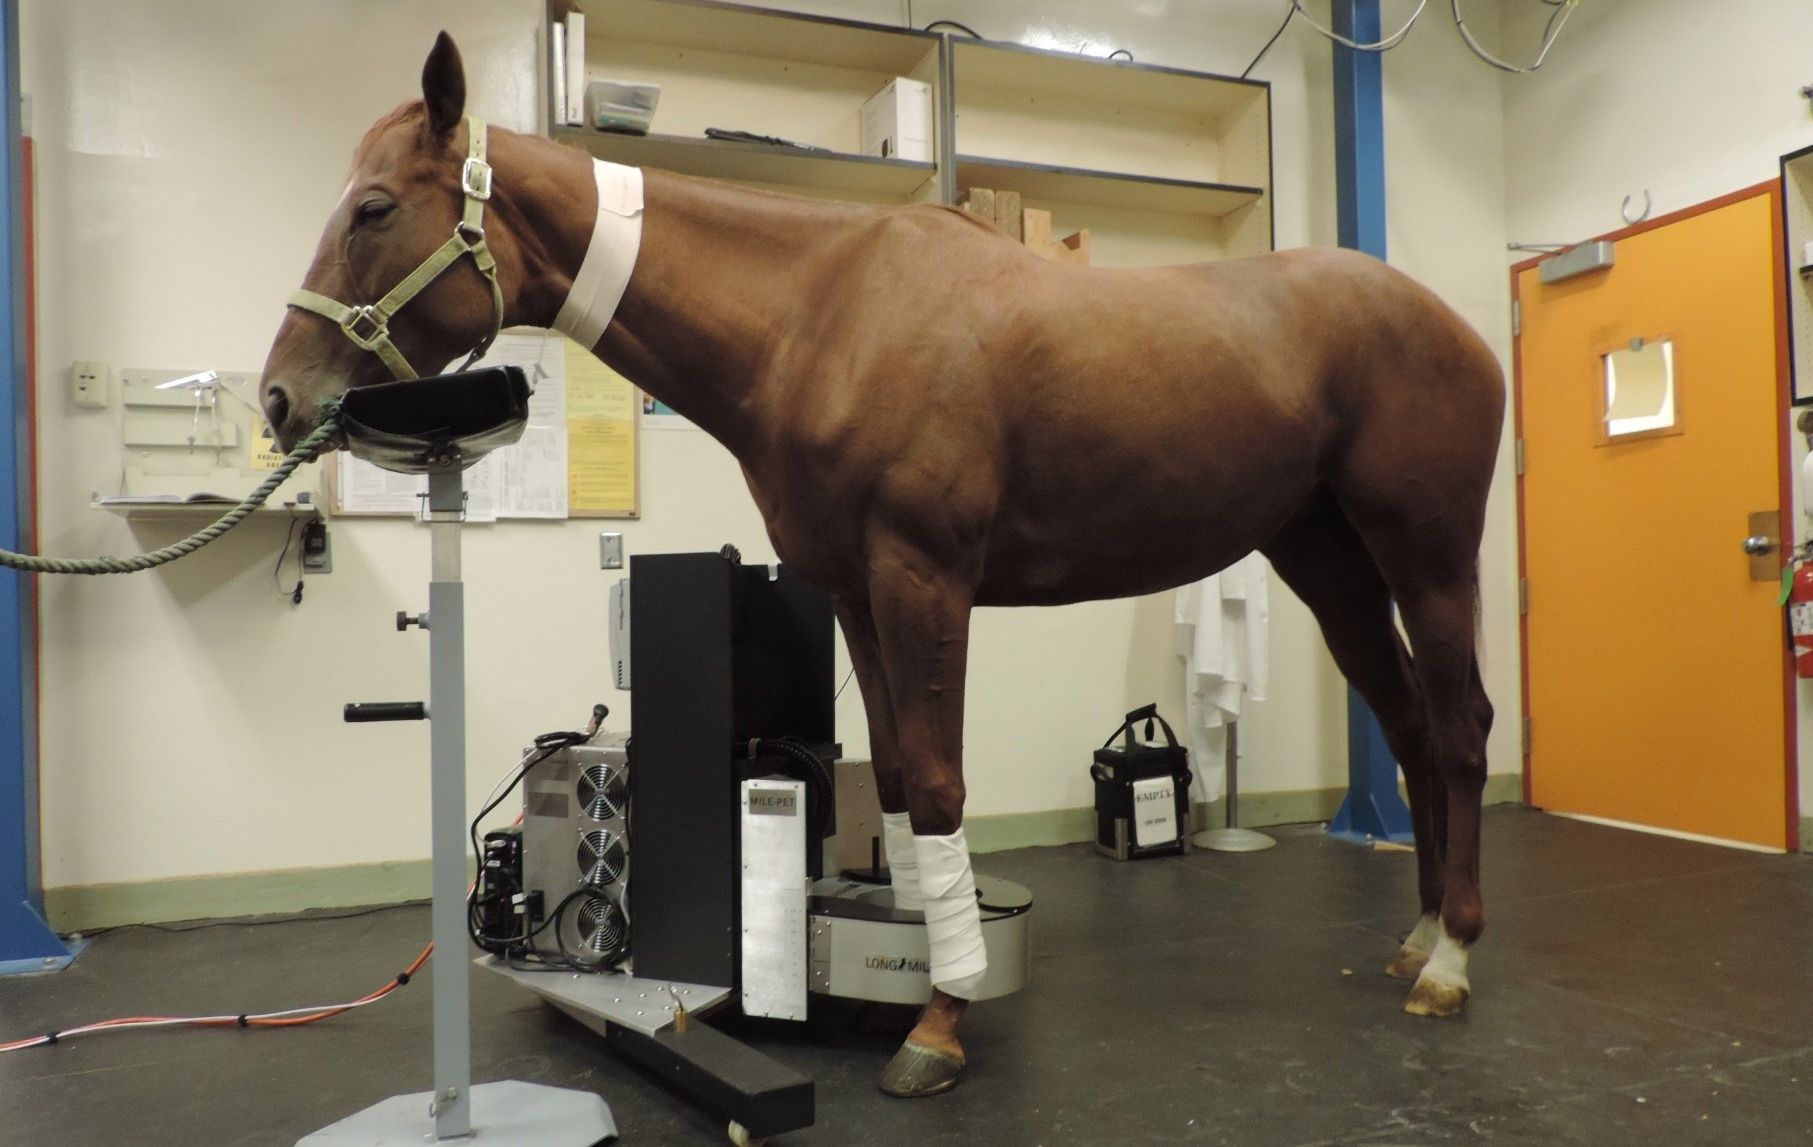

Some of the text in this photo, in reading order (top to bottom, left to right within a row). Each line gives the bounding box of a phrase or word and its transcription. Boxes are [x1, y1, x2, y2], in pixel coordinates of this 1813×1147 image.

[750, 797, 794, 807] MILE-PET
[864, 957, 931, 974] LONG MIL
